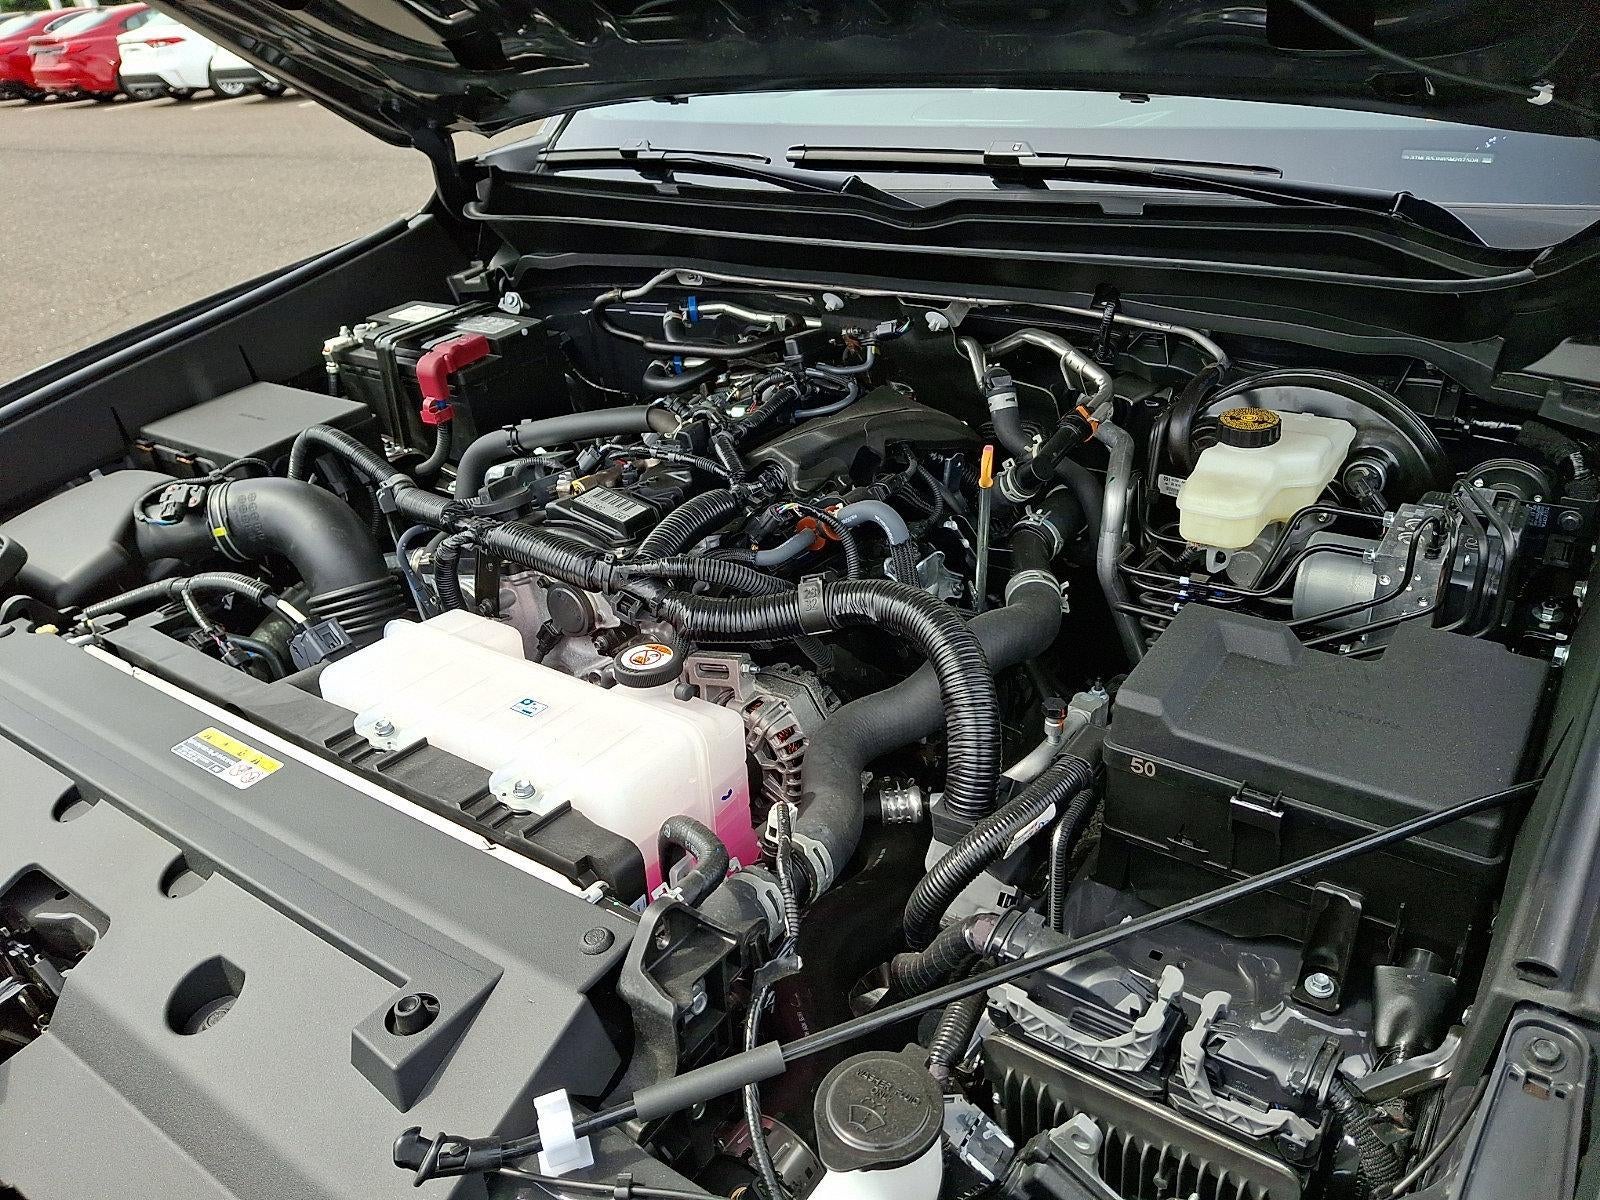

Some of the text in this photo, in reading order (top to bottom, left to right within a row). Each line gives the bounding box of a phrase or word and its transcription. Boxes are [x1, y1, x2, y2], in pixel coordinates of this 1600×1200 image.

[1130, 757, 1156, 777] 50
[857, 1069, 921, 1105] WASHER FLUID
[870, 1087, 894, 1103] ONLY
